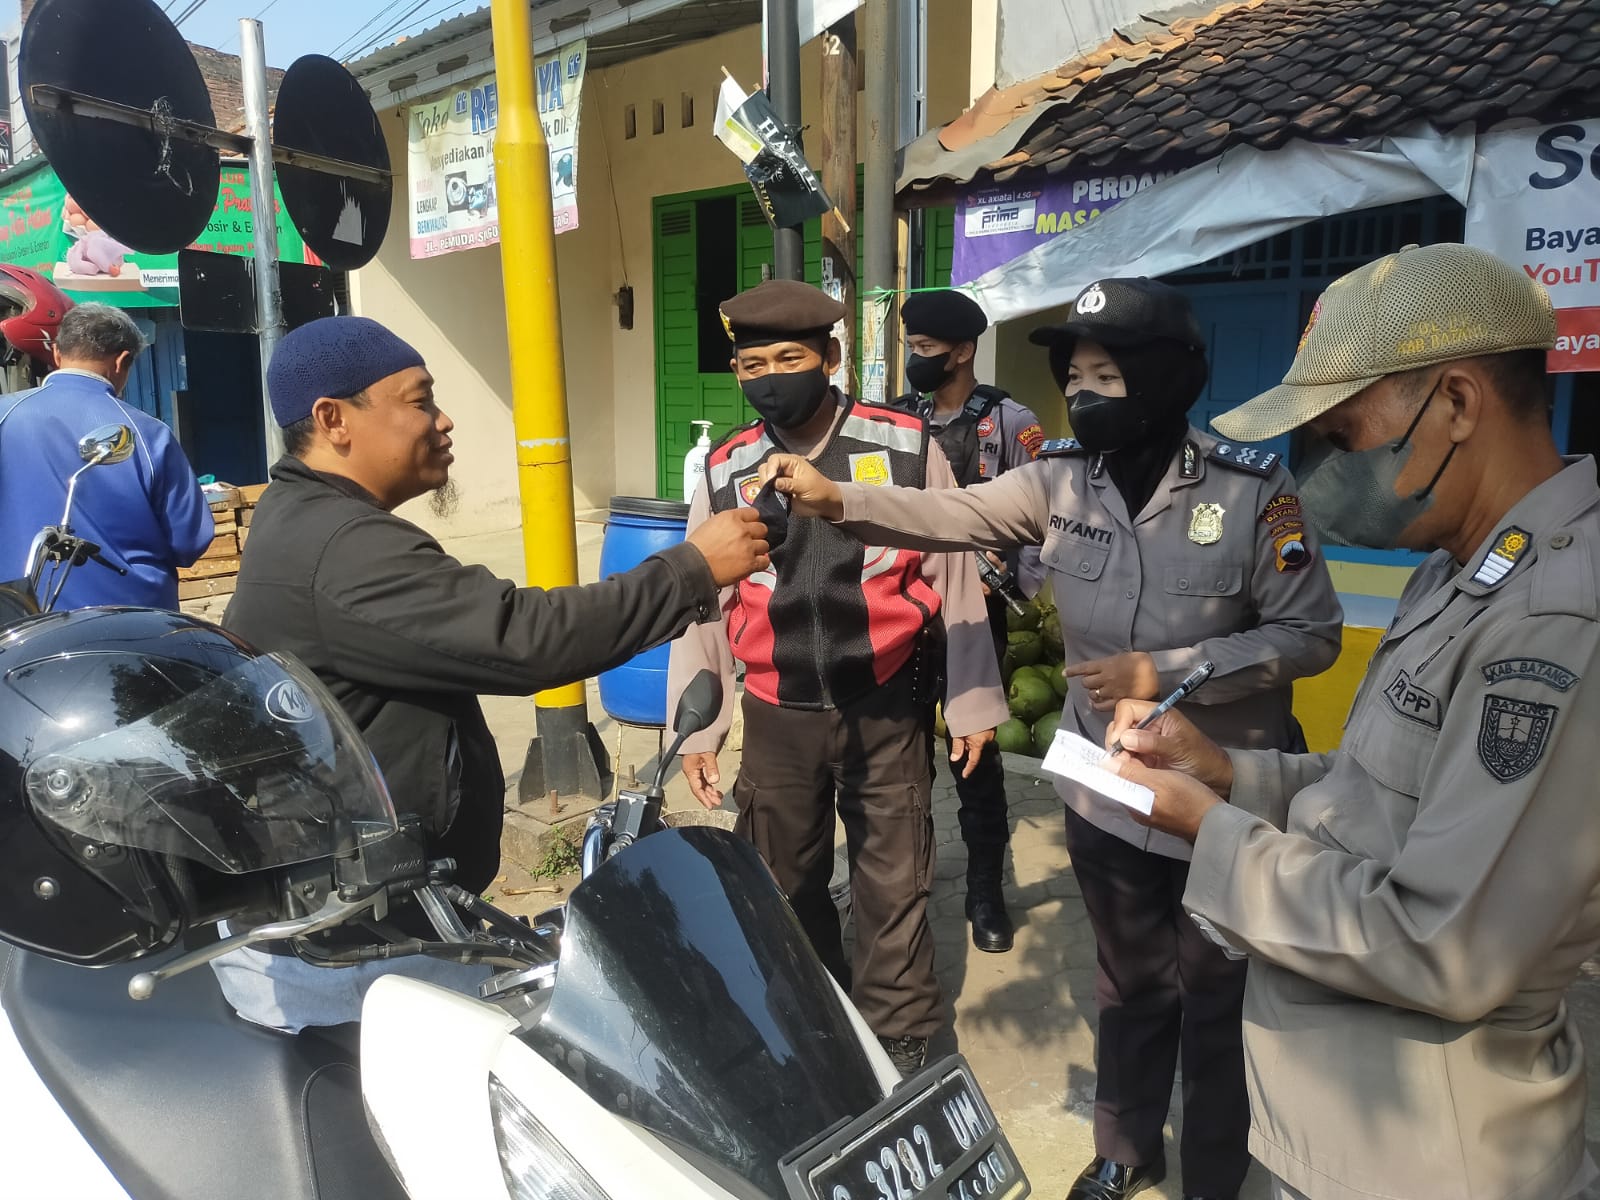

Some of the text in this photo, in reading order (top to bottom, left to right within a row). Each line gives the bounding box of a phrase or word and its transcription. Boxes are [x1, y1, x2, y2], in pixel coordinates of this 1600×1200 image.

[1529, 124, 1600, 190] S
[232, 220, 242, 233] &
[982, 206, 1020, 229] prima
[440, 232, 475, 250] PEMUDA
[1050, 514, 1113, 545] RIYANTI
[1520, 662, 1570, 685] BATANG
[1491, 698, 1550, 716] BATANG
